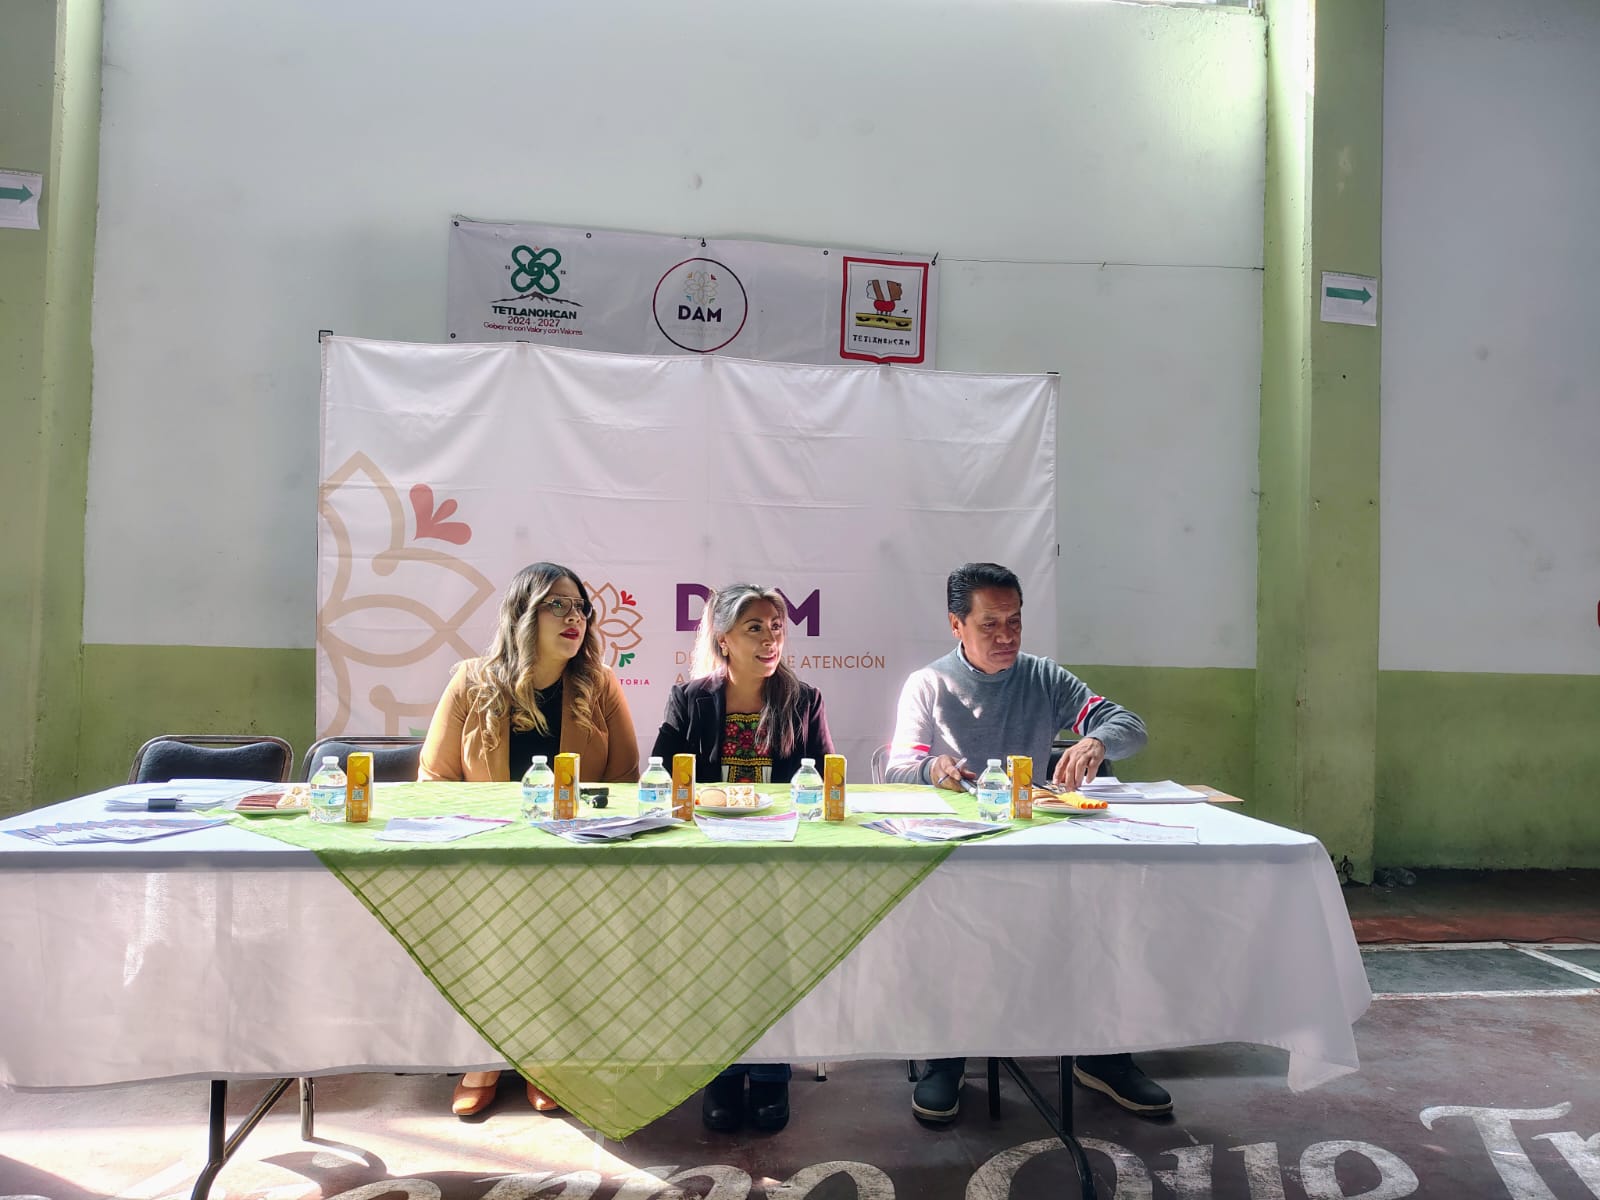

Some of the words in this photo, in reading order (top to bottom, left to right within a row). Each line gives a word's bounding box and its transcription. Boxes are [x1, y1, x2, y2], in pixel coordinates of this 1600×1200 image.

[492, 306, 577, 319] TETLANOHCAN
[678, 304, 722, 322] DAM
[507, 316, 531, 326] 2024
[537, 318, 560, 328] 2027
[676, 583, 820, 637] DM
[800, 651, 885, 669] ATENCIÓN
